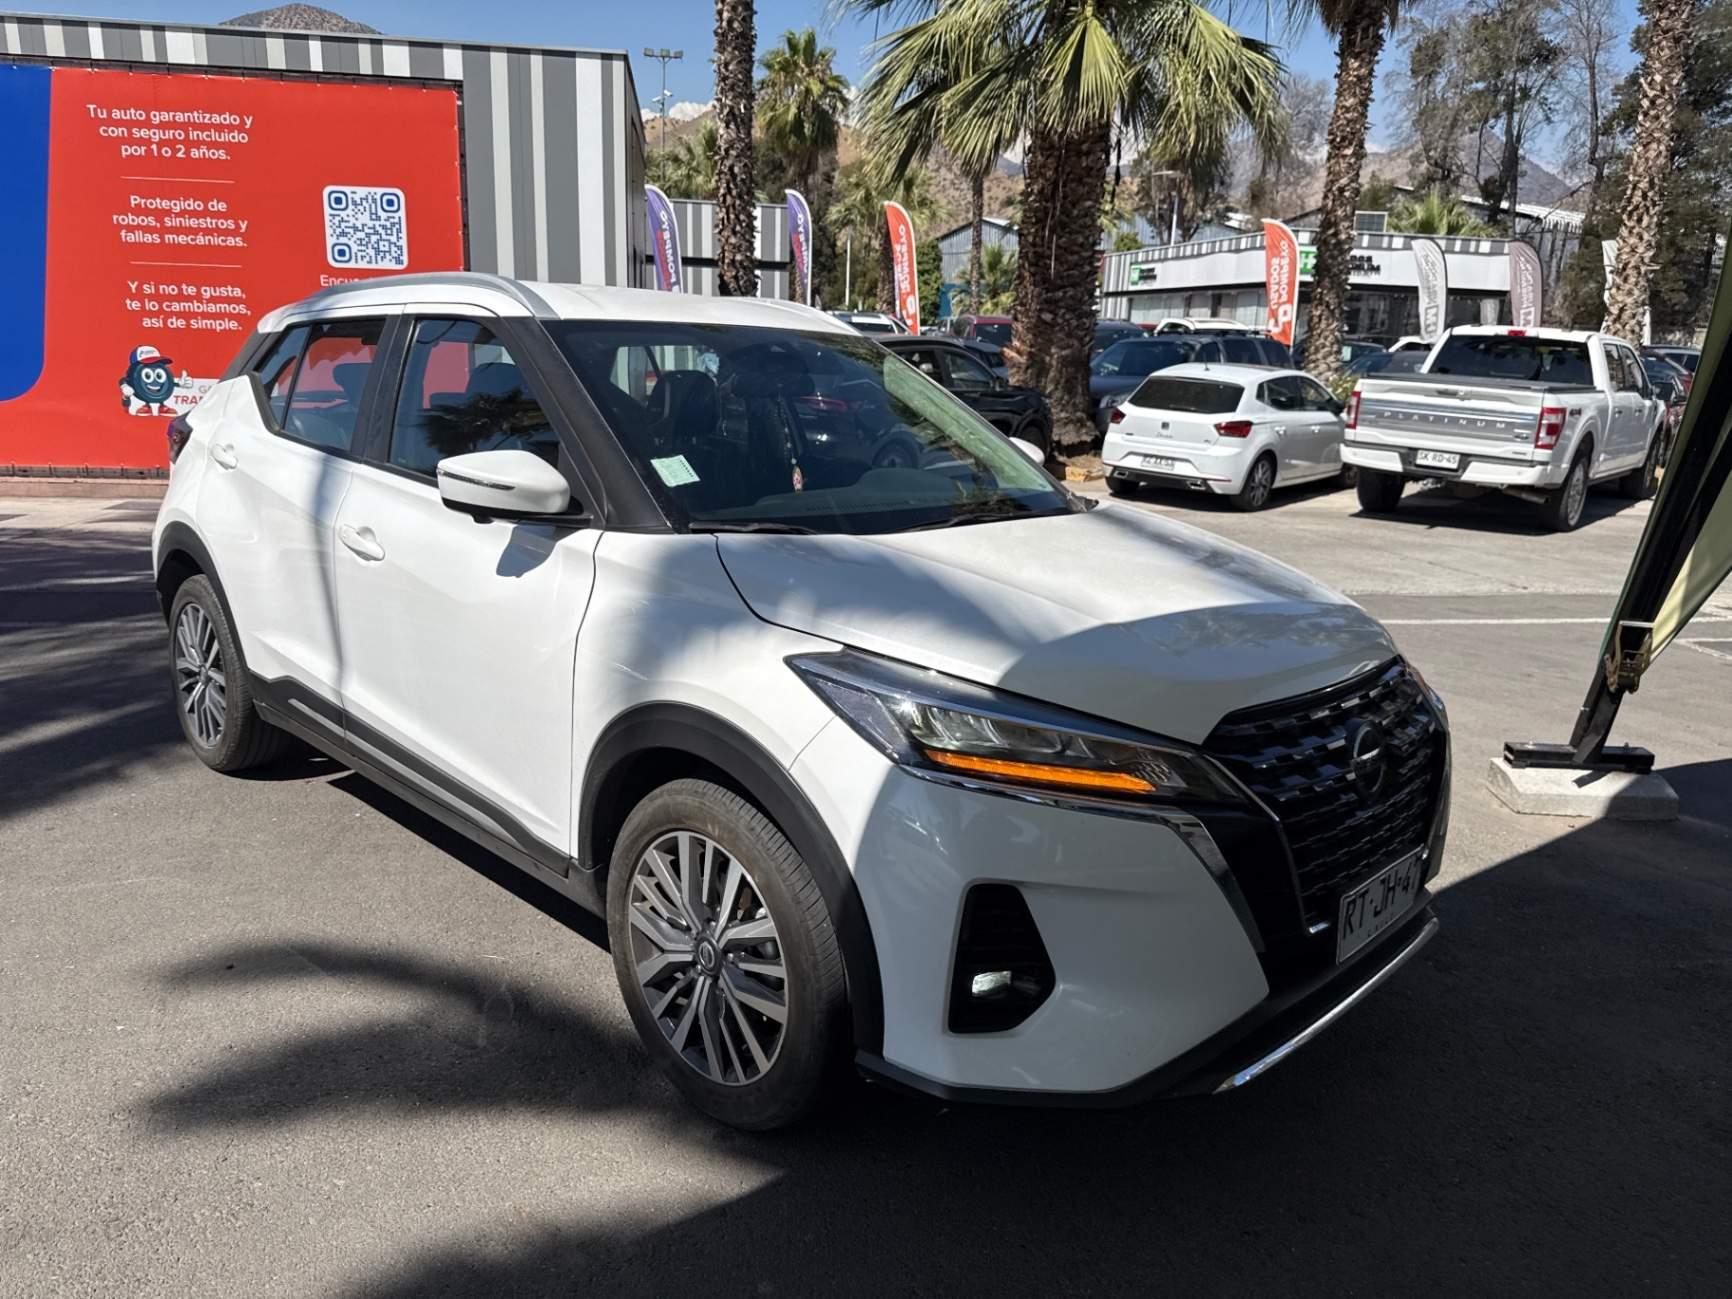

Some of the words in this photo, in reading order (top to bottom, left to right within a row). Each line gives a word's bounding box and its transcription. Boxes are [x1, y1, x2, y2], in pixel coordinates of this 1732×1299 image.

[86, 104, 107, 118] Tu
[112, 108, 146, 120] auto
[150, 110, 240, 125] garantizado
[244, 115, 252, 128] y
[99, 126, 128, 138] con
[132, 126, 184, 142] seguro
[188, 128, 248, 143] incluido
[121, 144, 146, 158] por
[150, 144, 158, 156] 1
[161, 147, 172, 158] o
[175, 145, 186, 158] 2
[190, 146, 231, 160] años.
[130, 195, 204, 212] Protegido
[208, 198, 228, 212] de
[112, 213, 160, 228] robos,
[164, 214, 236, 230] siniestros
[238, 219, 248, 232] y
[120, 230, 160, 244] fallas
[164, 232, 248, 247] mecánicas.
[128, 281, 138, 294] Y
[142, 282, 155, 294] si
[160, 284, 178, 296] no
[182, 283, 196, 296] te
[201, 284, 246, 299] gusta,
[126, 298, 141, 310] te
[145, 298, 158, 311] lo
[162, 300, 252, 316] cambiamos,
[142, 315, 164, 328] así
[168, 316, 186, 328] de
[190, 316, 242, 333] simple.
[1384, 411, 1505, 428] PLATINUM
